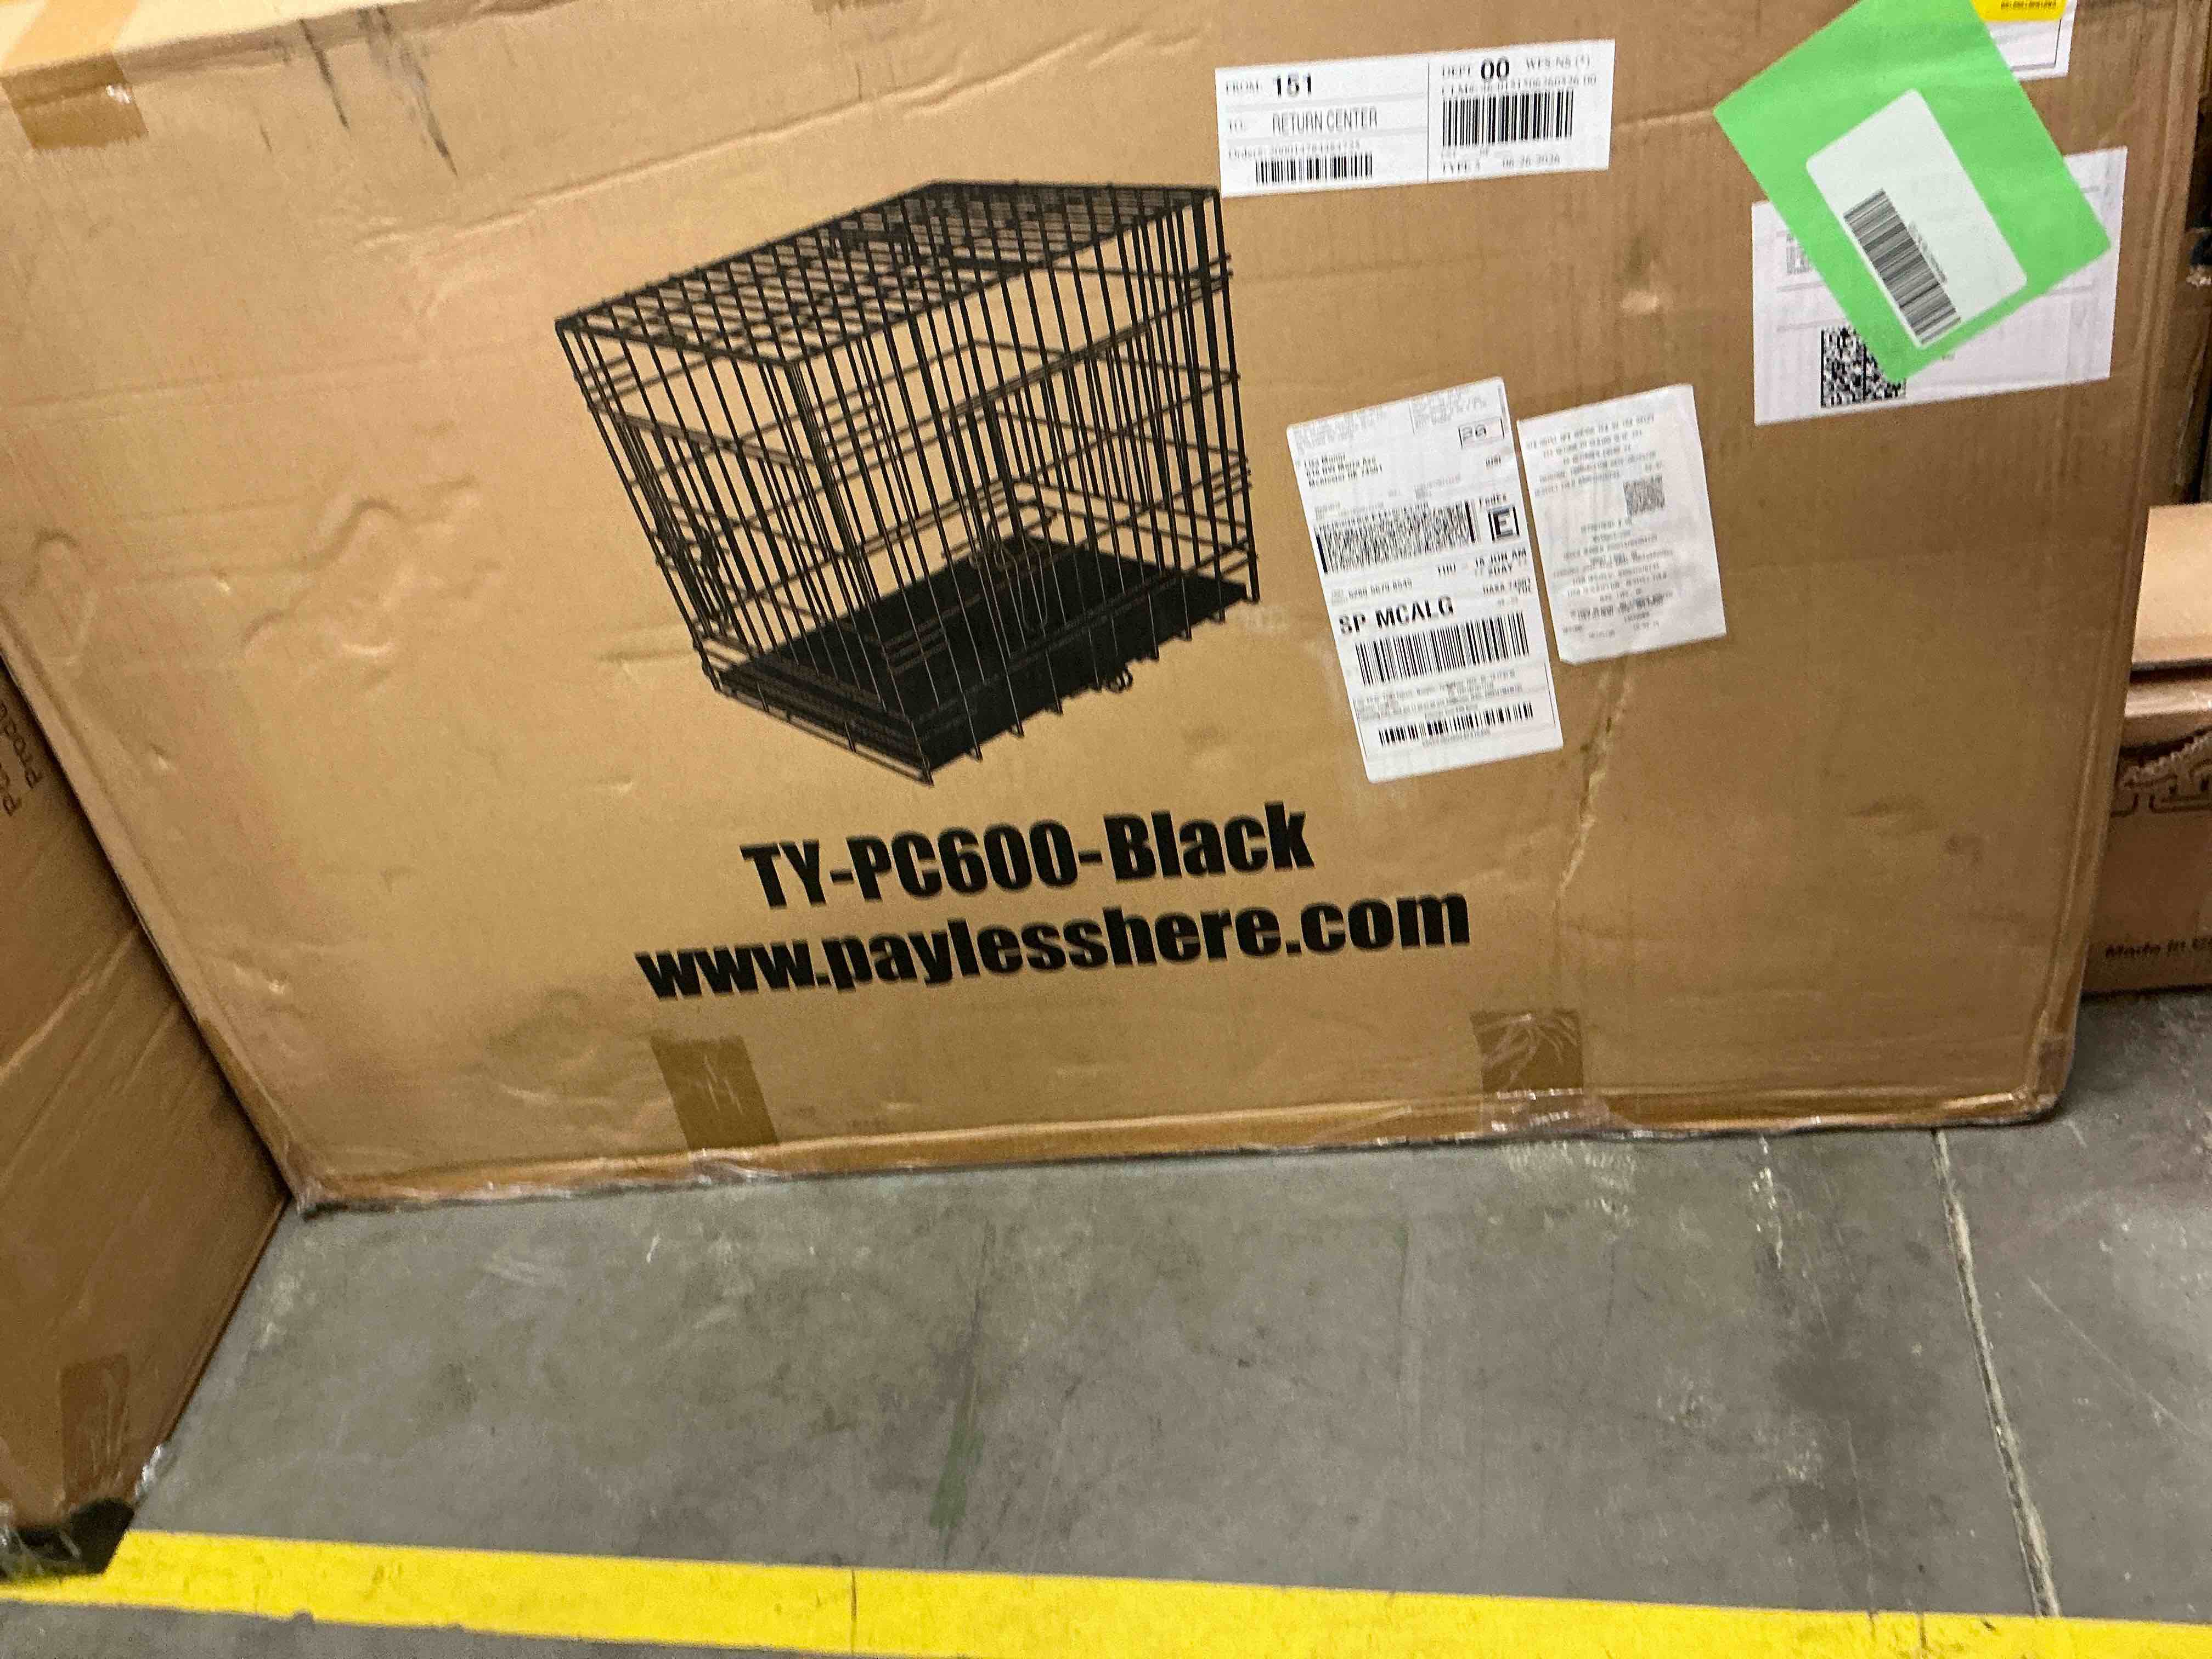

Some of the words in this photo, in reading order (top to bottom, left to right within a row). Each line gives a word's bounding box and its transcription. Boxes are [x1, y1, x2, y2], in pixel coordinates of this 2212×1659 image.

[1272, 71, 1313, 98] 151
[1481, 58, 1510, 82] 00
[1271, 110, 1323, 136] RETURN
[1326, 106, 1378, 132] CENTER
[1493, 507, 1515, 539] E
[738, 801, 1315, 909] TY-PC600-Black
[634, 893, 1471, 1002] www.paylesshere.com
